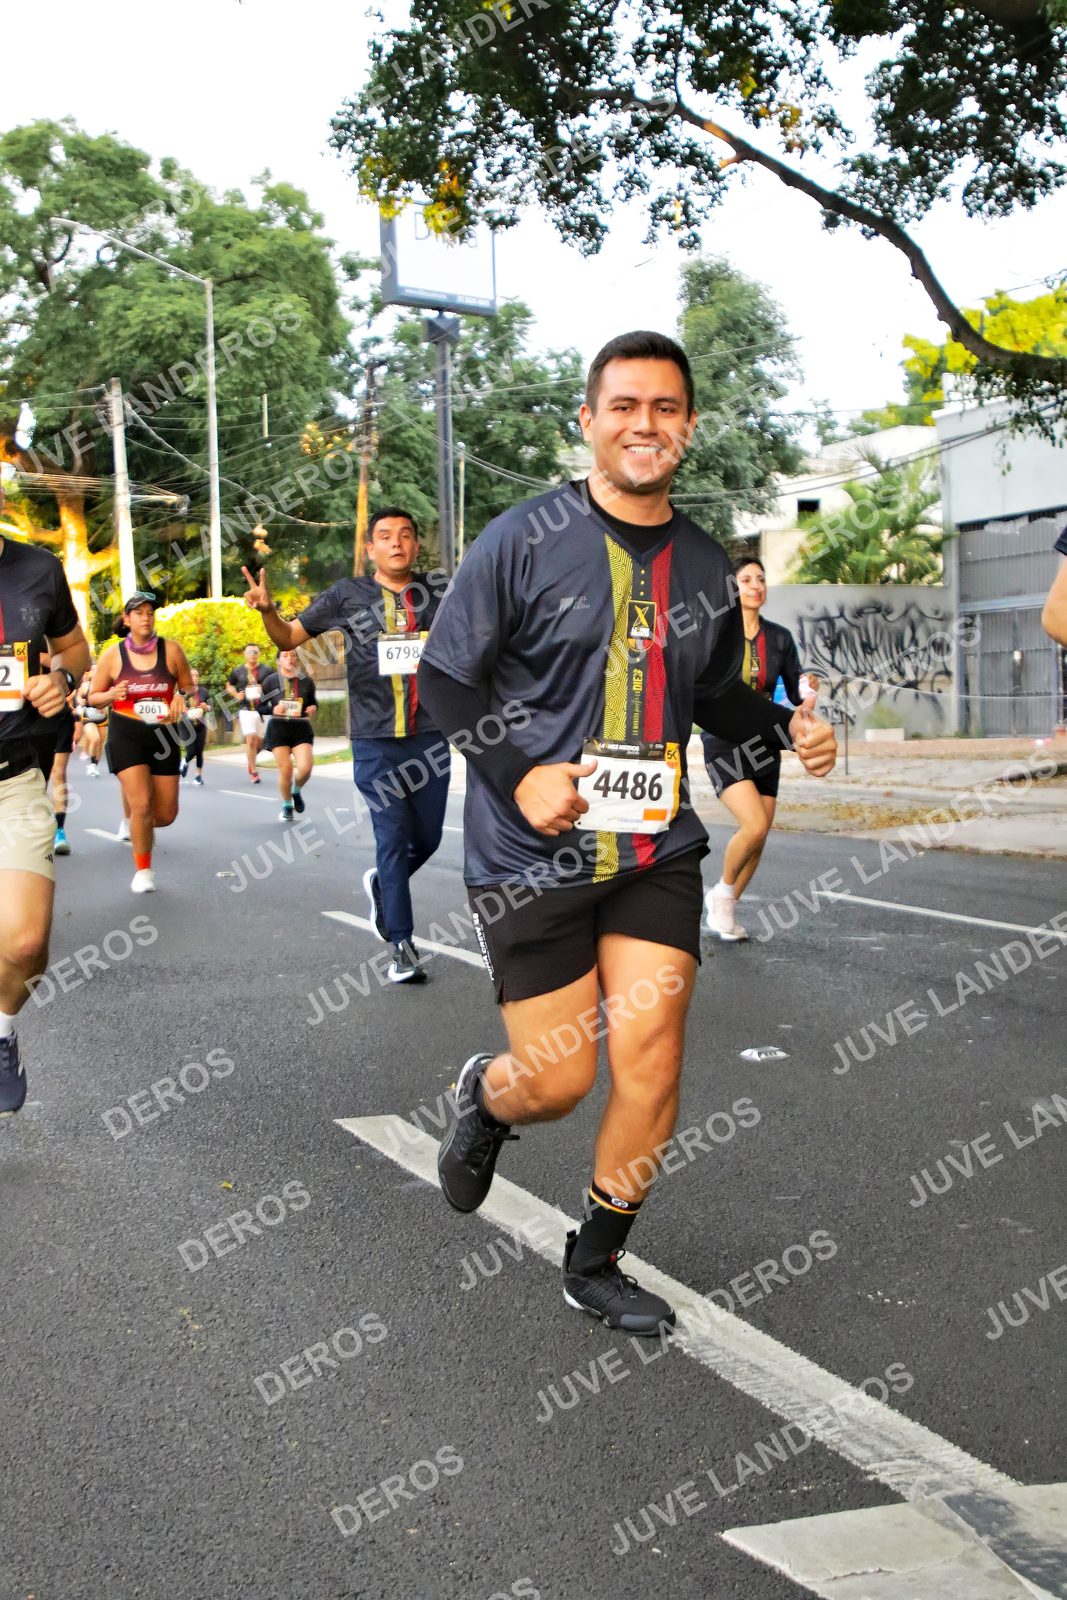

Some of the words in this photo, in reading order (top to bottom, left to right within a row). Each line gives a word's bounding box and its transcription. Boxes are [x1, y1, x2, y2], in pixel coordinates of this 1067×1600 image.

[386, 646, 420, 660] 6798
[139, 705, 162, 714] 2061
[593, 769, 663, 801] 4486
